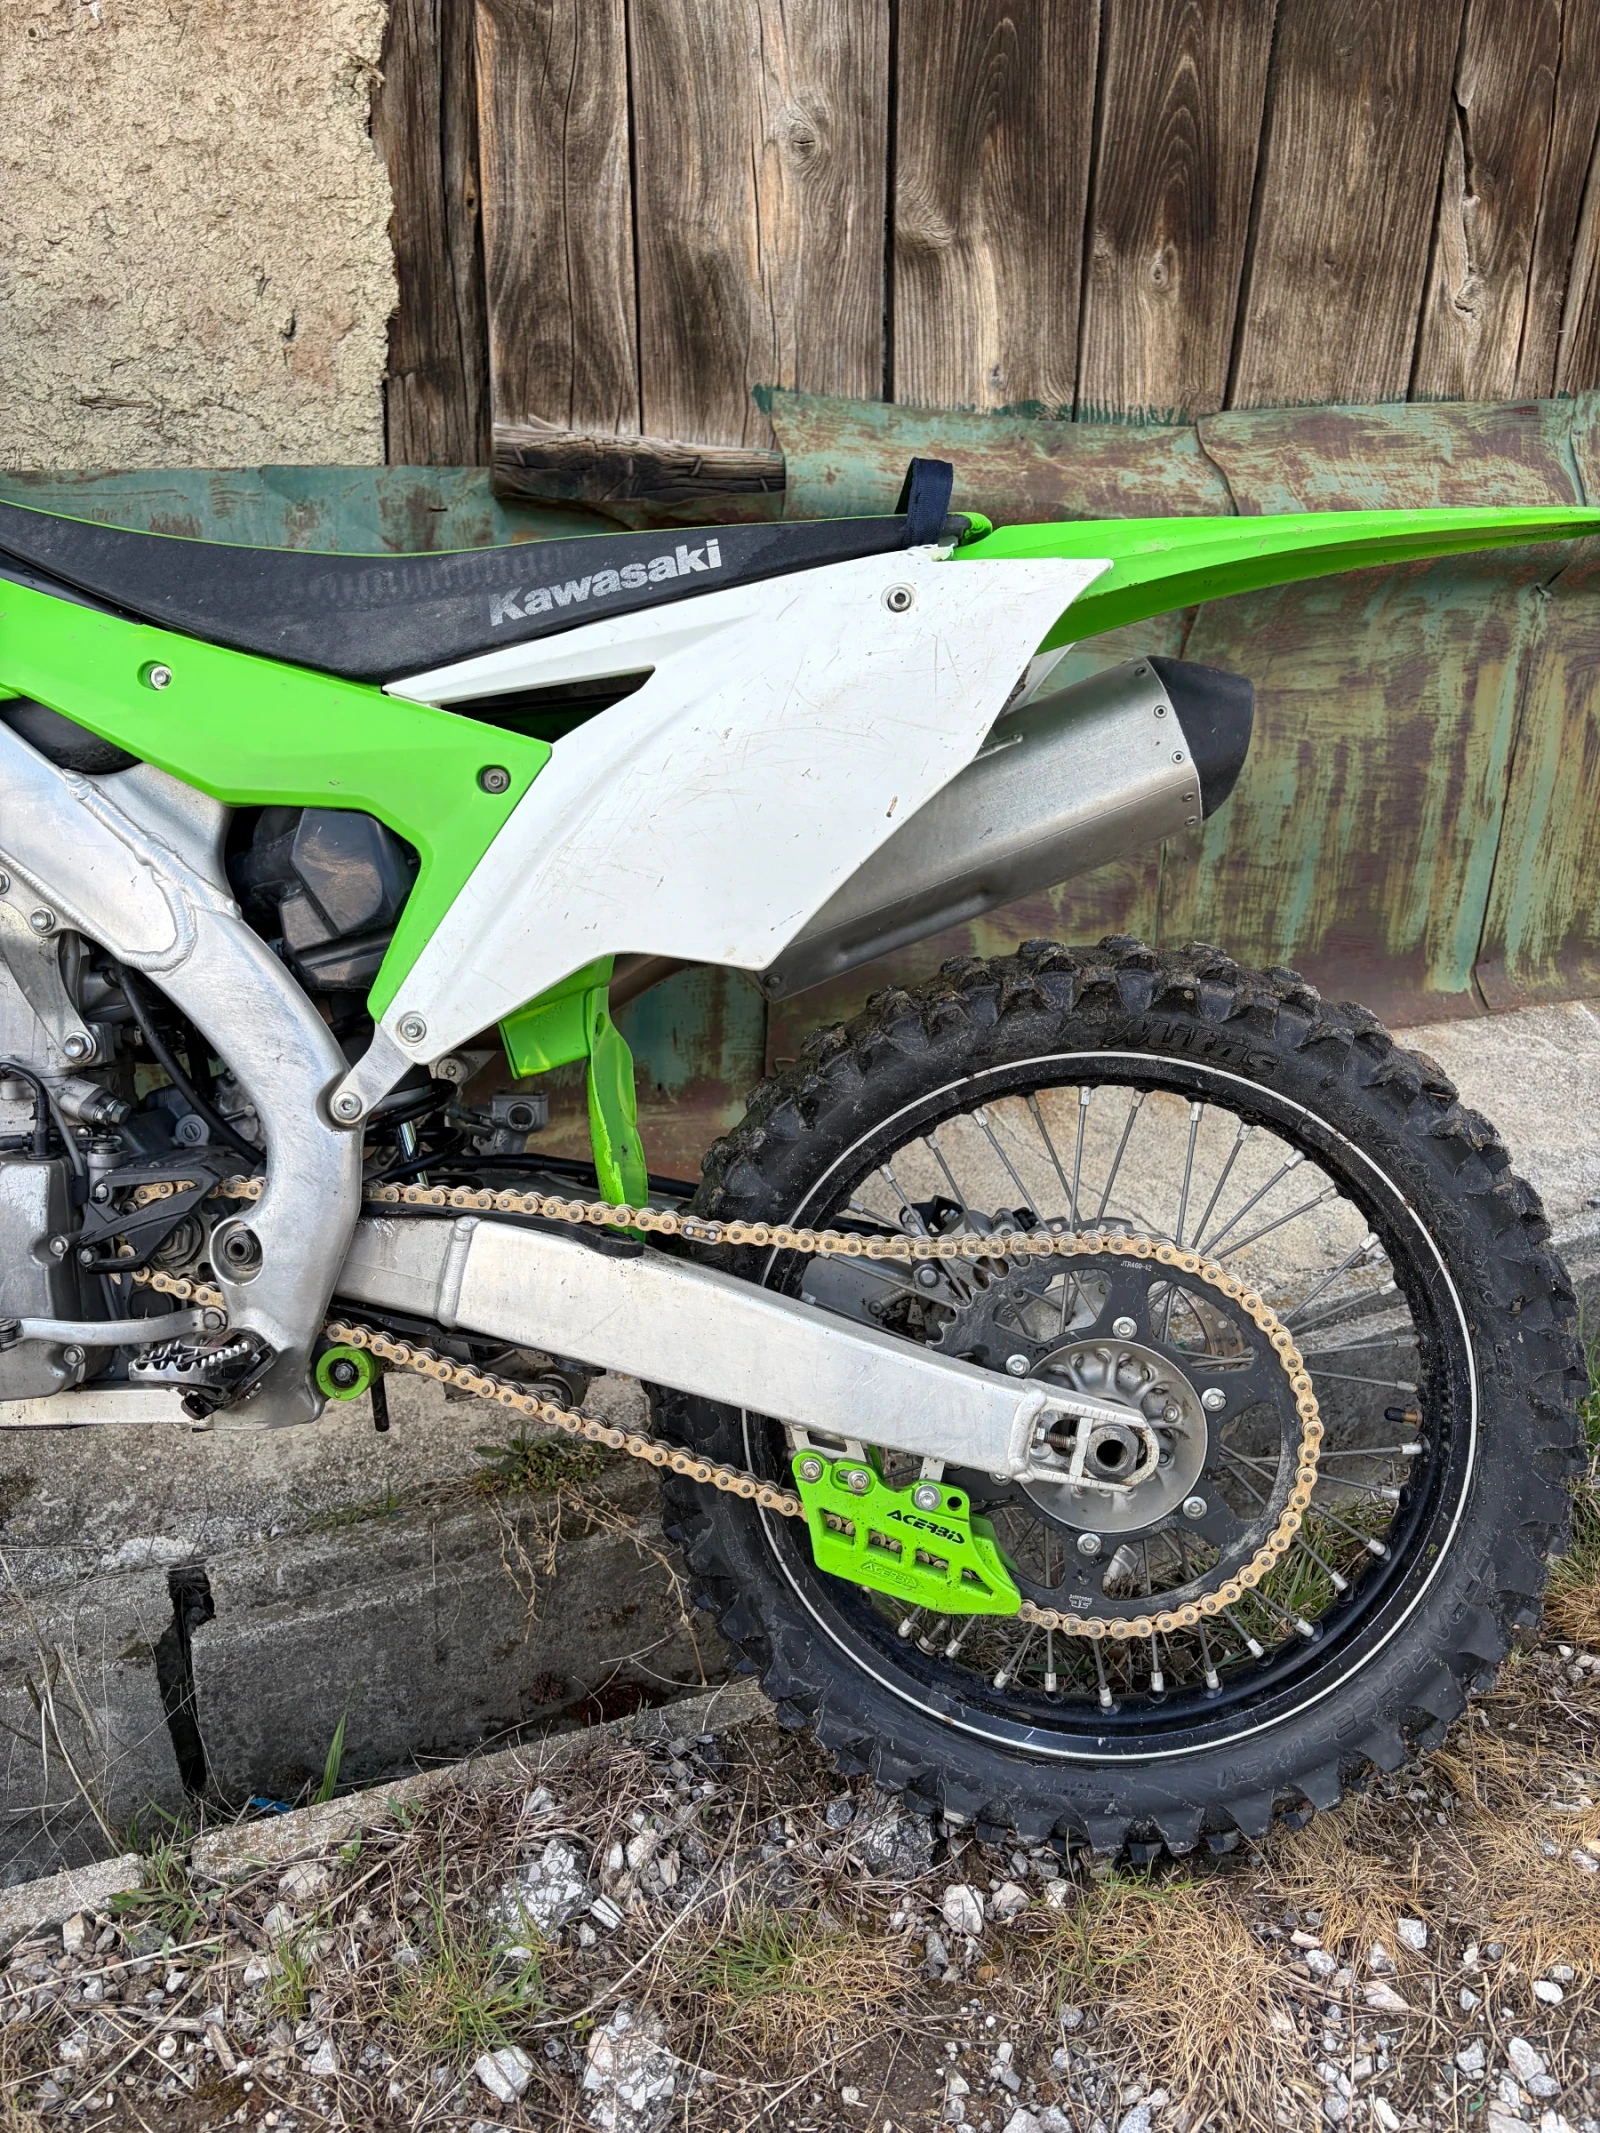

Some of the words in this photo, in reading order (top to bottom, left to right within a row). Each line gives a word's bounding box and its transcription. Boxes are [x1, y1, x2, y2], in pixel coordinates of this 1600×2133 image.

[488, 538, 722, 627] Kawasaki
[1102, 1018, 1280, 1078] Mitas
[886, 1509, 966, 1544] ACERBIS
